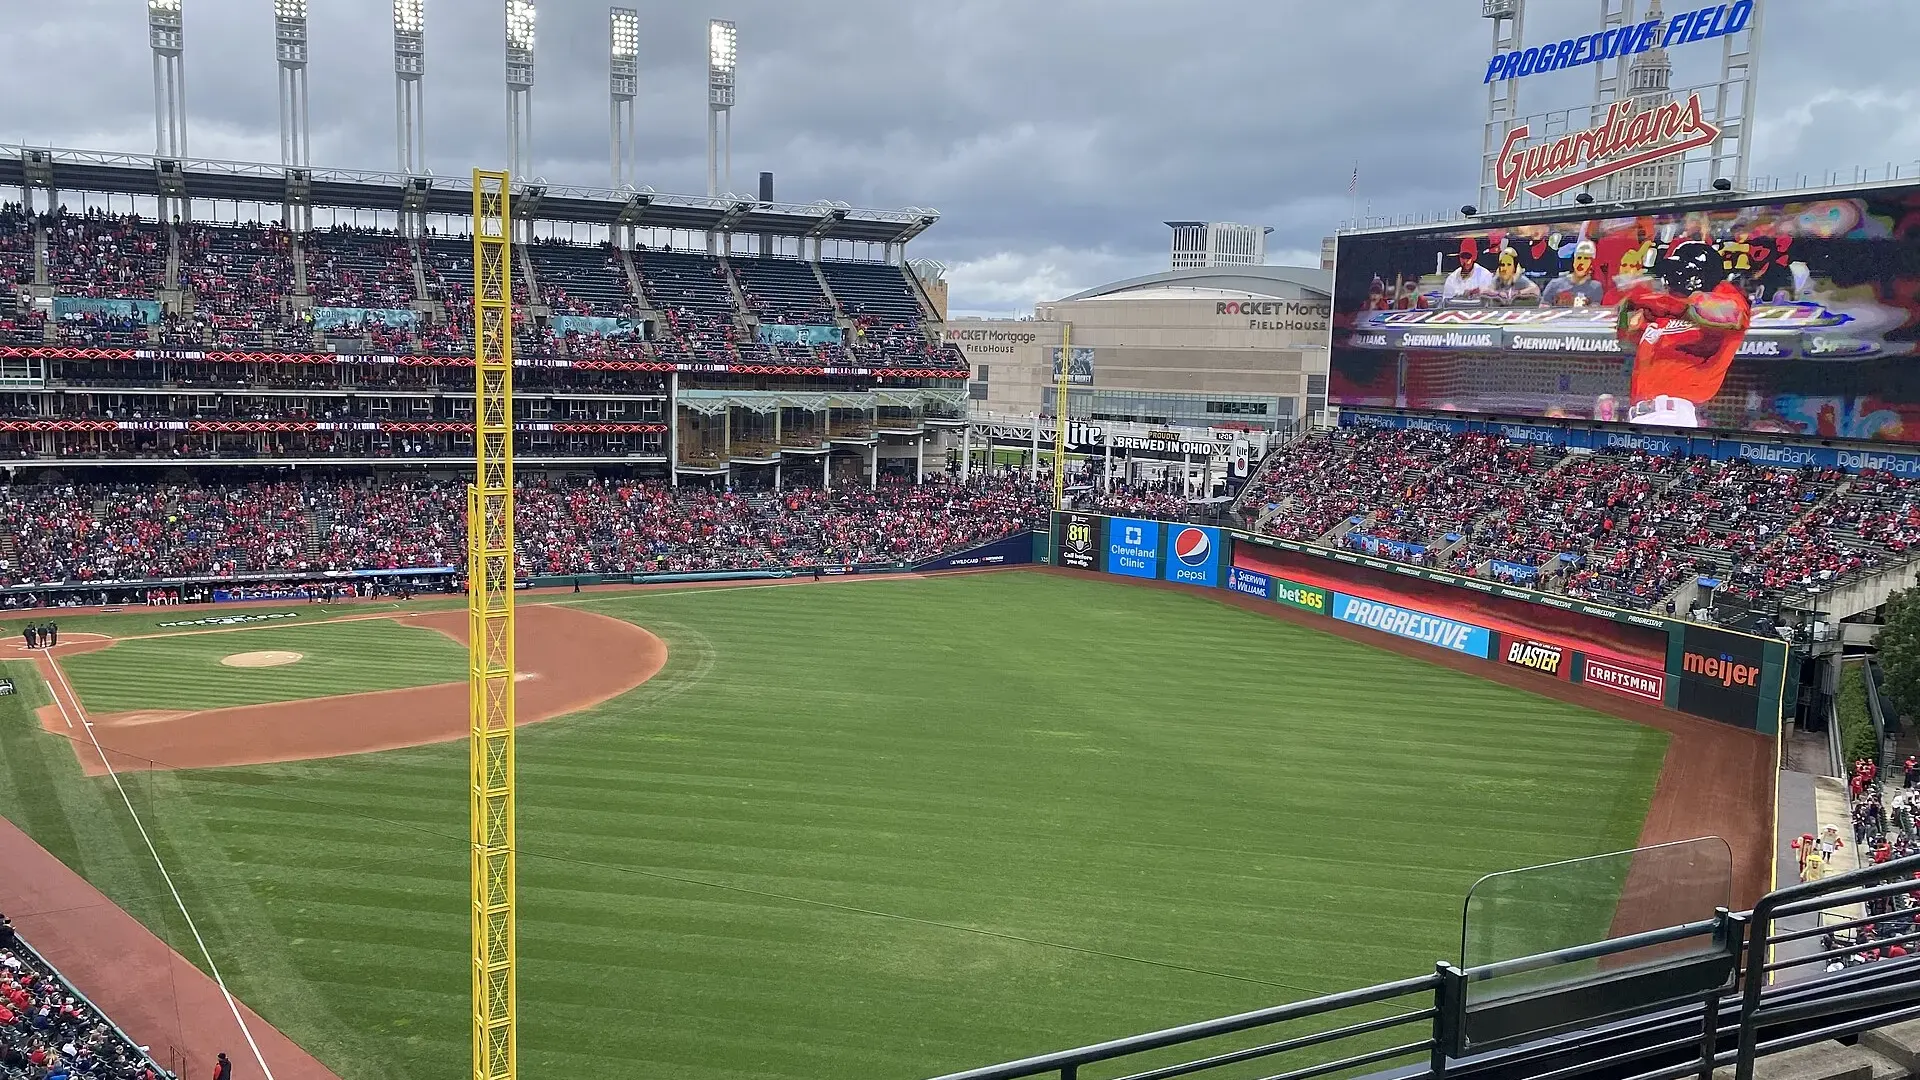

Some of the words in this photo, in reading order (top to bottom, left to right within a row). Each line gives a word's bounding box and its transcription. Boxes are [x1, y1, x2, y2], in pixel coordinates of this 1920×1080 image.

[1484, 20, 1660, 84] PROGRESSIVE
[1662, 0, 1754, 48] FIELD
[1495, 92, 1721, 208] Guardians
[1216, 302, 1283, 315] ROCKET
[1286, 302, 1330, 318] Mortg
[946, 330, 988, 340] ROCKET
[989, 330, 1036, 344] Mortgage
[1149, 431, 1180, 440] PROUDLY
[1118, 437, 1165, 452] BREWED
[1166, 442, 1180, 453] IN
[1183, 442, 1211, 455] OHIO
[1069, 524, 1088, 542] 811
[1112, 544, 1155, 558] Cleveland
[1120, 557, 1145, 568] Clinic
[1177, 569, 1206, 582] pepsi
[1238, 572, 1266, 586] SHERWIN
[1464, 580, 1492, 592] PROGRESSIVE
[1280, 584, 1323, 608] bet365
[1501, 588, 1530, 600] PROGRESSIVE
[1541, 596, 1572, 609] PROGRESSIVE
[1583, 606, 1616, 618] PROGRESSIVE
[1344, 600, 1472, 650] PROGRESSIVE
[1628, 615, 1664, 628] PROGRESSIVE
[1508, 642, 1560, 672] BLASTER
[1684, 652, 1758, 687] meijer
